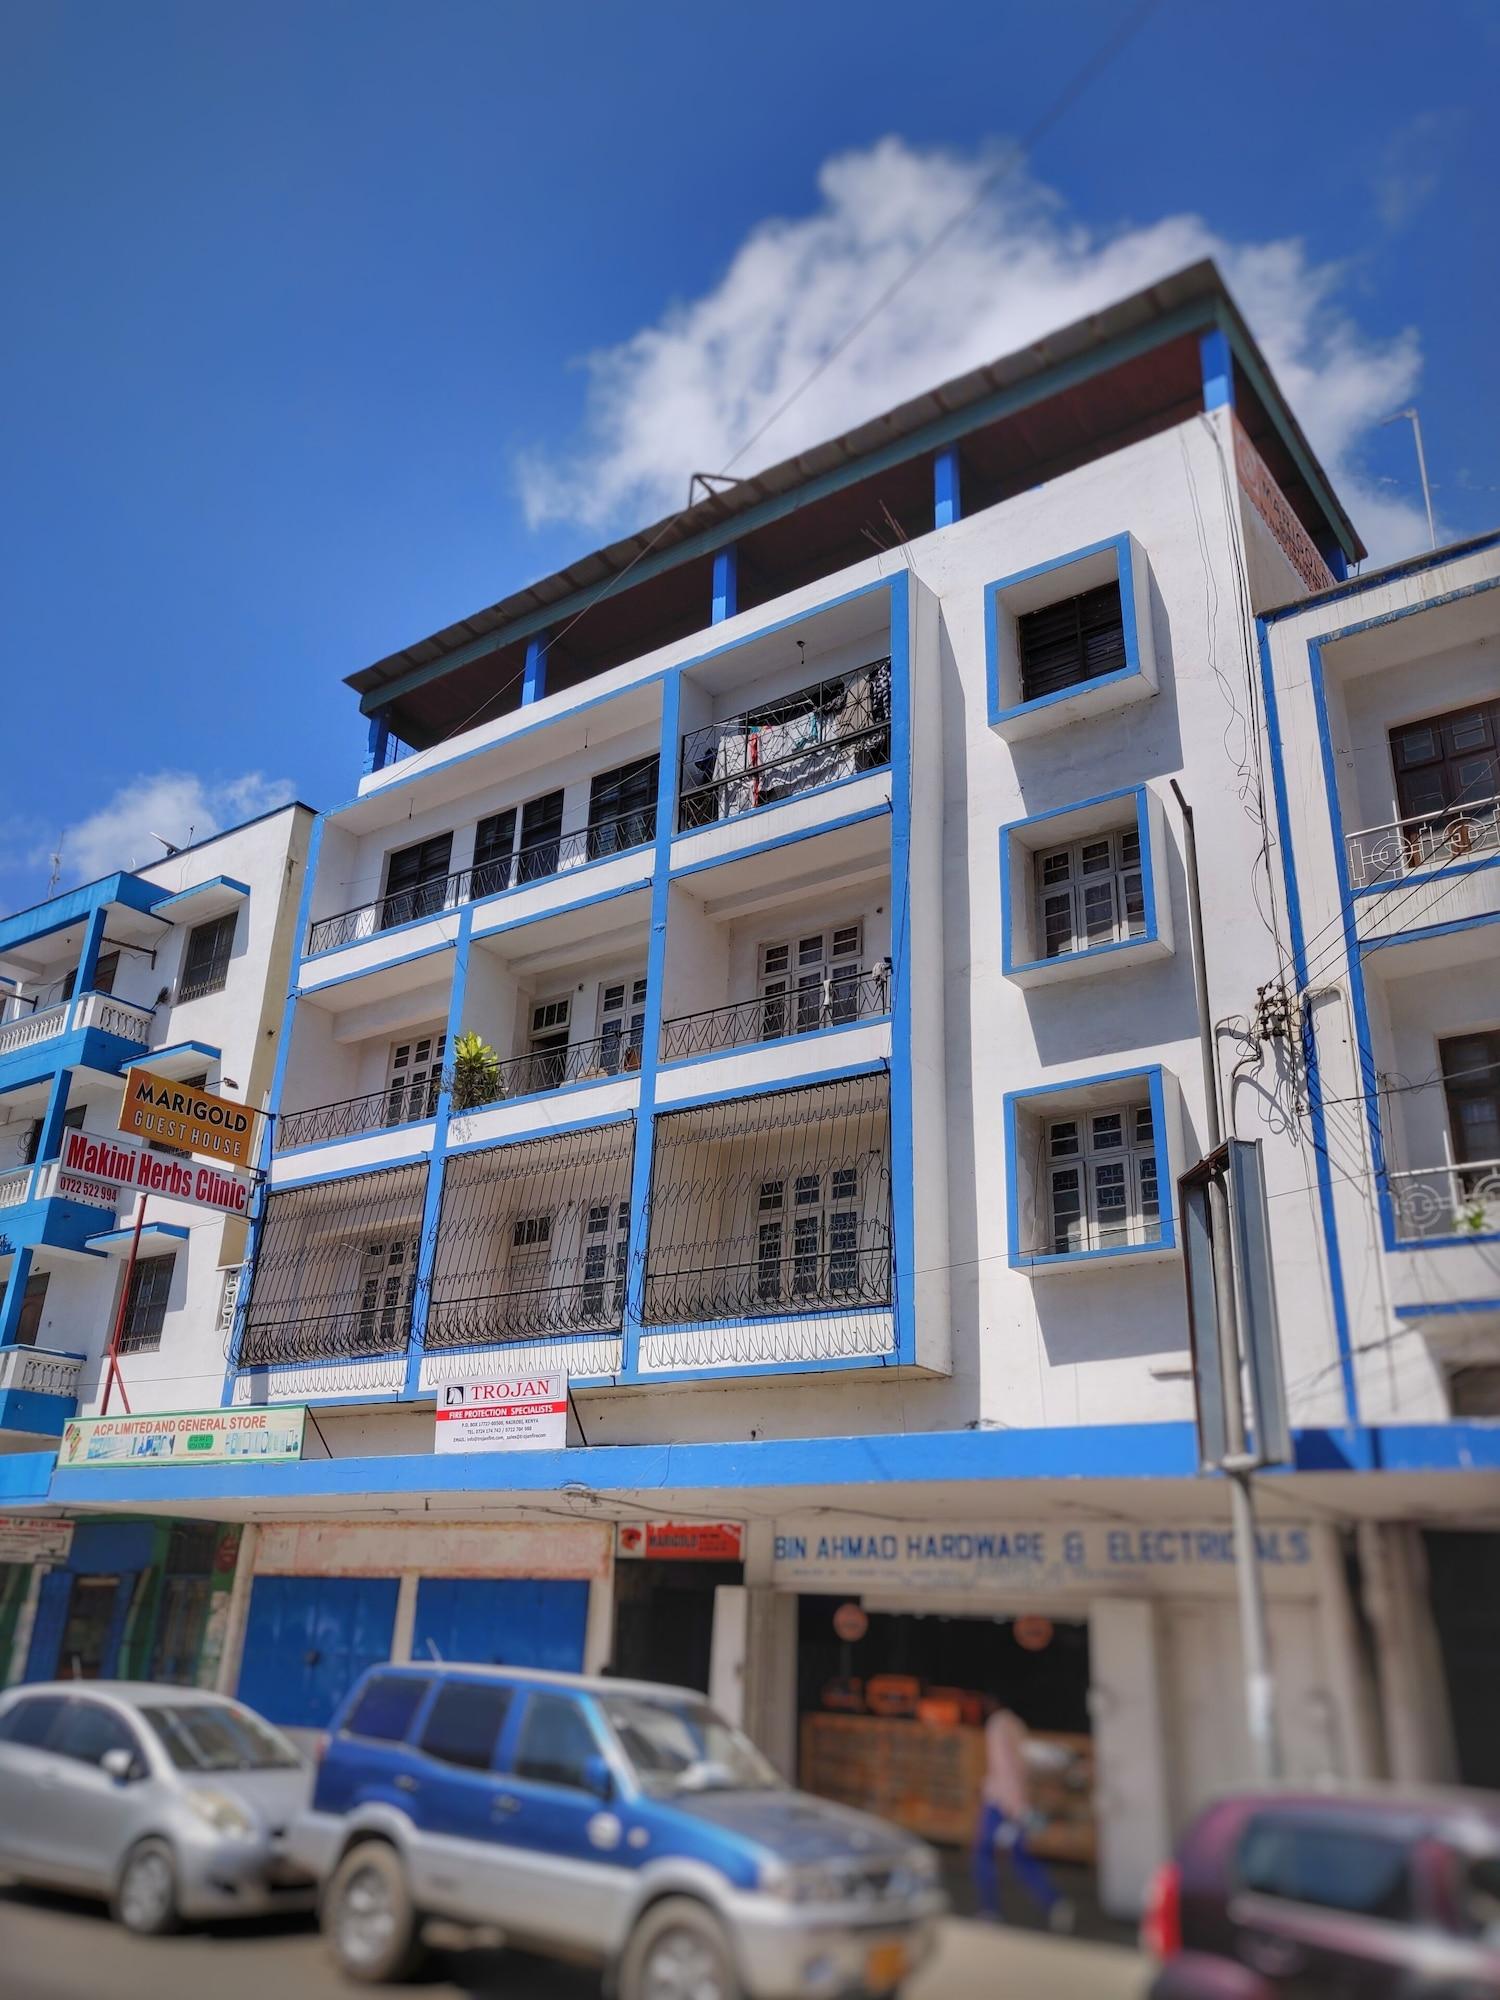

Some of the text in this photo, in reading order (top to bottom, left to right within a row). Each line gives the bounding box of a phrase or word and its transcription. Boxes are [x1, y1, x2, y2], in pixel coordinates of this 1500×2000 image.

[136, 1082, 248, 1132] MARIGOLD
[134, 1110, 241, 1157] GUEST HOUSE
[66, 1134, 246, 1210] Makini Herbs Clinic
[60, 1177, 117, 1203] 0722 522 994
[472, 1380, 549, 1400] TROJAN
[94, 1415, 267, 1436] ACP LIMITED AND GENERAL STORE
[449, 1405, 553, 1419] FIRE PROTECTION SPECIALISTS
[775, 1534, 806, 1559] BIN
[816, 1534, 897, 1560] AHMAD
[907, 1532, 1047, 1561] HARDWARE
[1064, 1532, 1085, 1563] &
